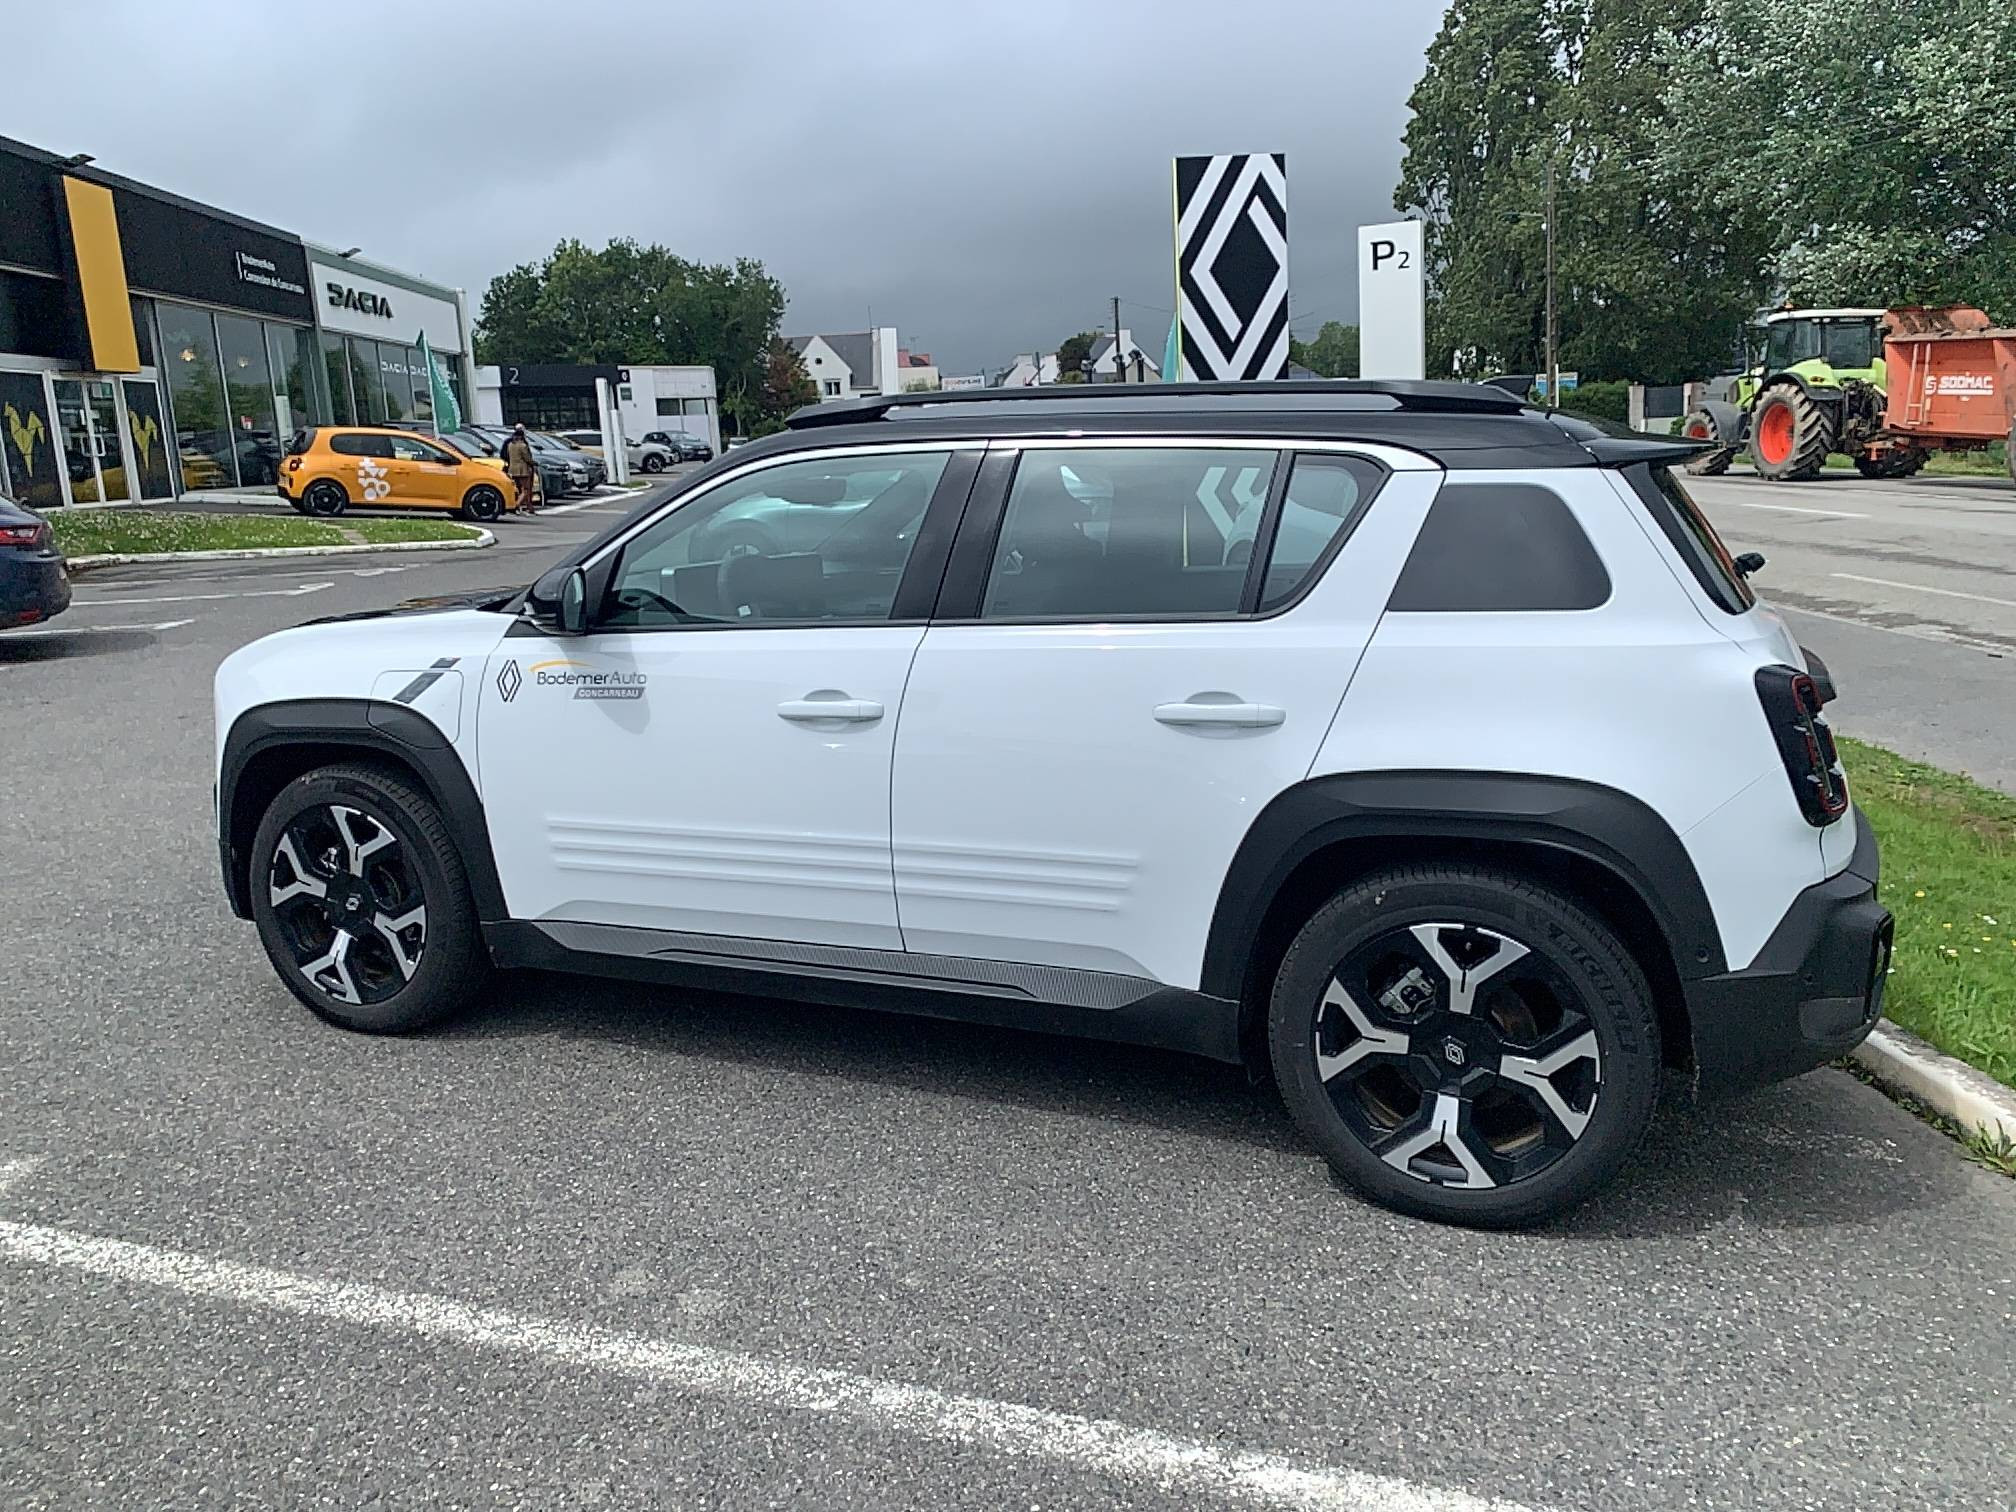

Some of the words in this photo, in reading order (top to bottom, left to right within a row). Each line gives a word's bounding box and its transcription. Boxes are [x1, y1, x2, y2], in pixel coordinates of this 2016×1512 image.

[1370, 240, 1410, 270] P2
[326, 282, 394, 319] DACIA
[509, 367, 520, 385] 2
[579, 688, 640, 698] CONCARNEAU
